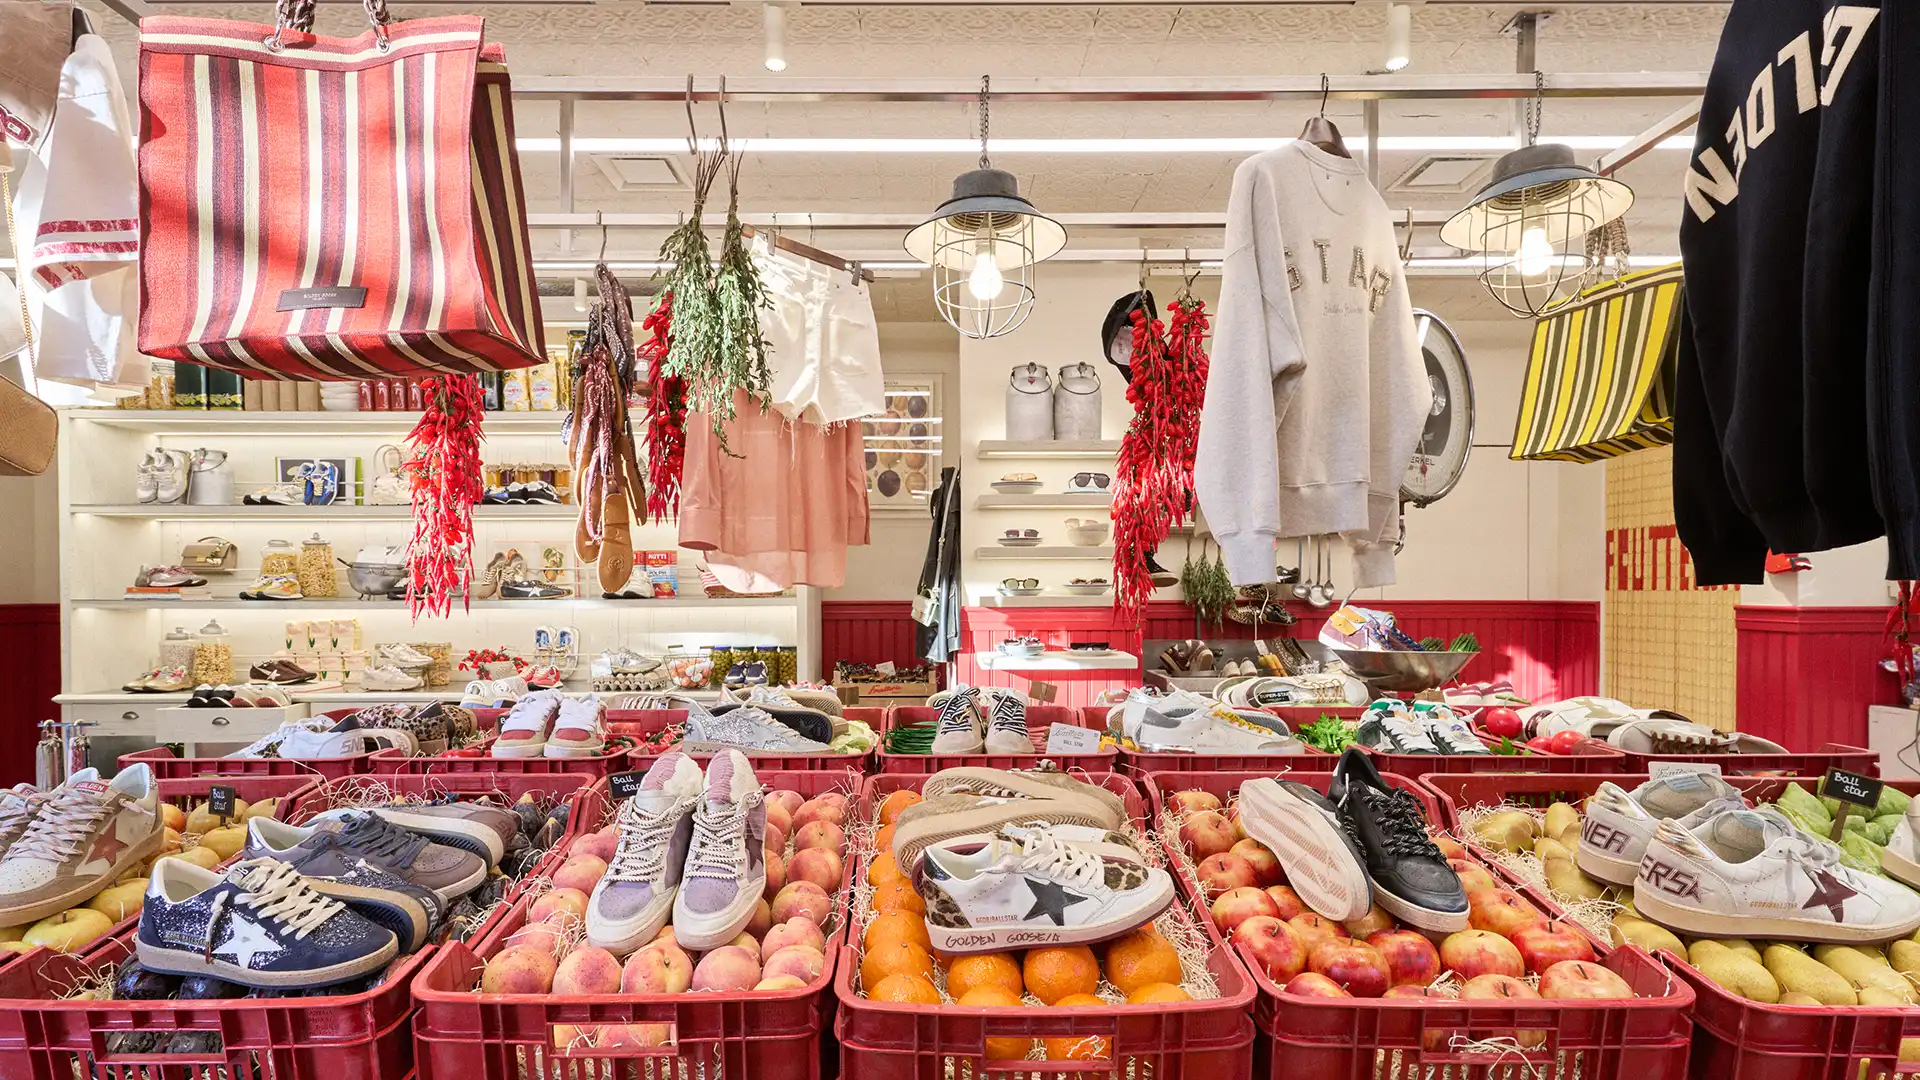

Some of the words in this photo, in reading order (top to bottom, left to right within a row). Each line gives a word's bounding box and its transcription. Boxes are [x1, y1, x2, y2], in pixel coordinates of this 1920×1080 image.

[1410, 456, 1435, 466] ERKEL
[612, 775, 634, 785] Ball
[1834, 771, 1860, 787] Ball
[622, 783, 641, 792] star
[1843, 784, 1869, 798] star
[946, 933, 996, 949] GOLDEN
